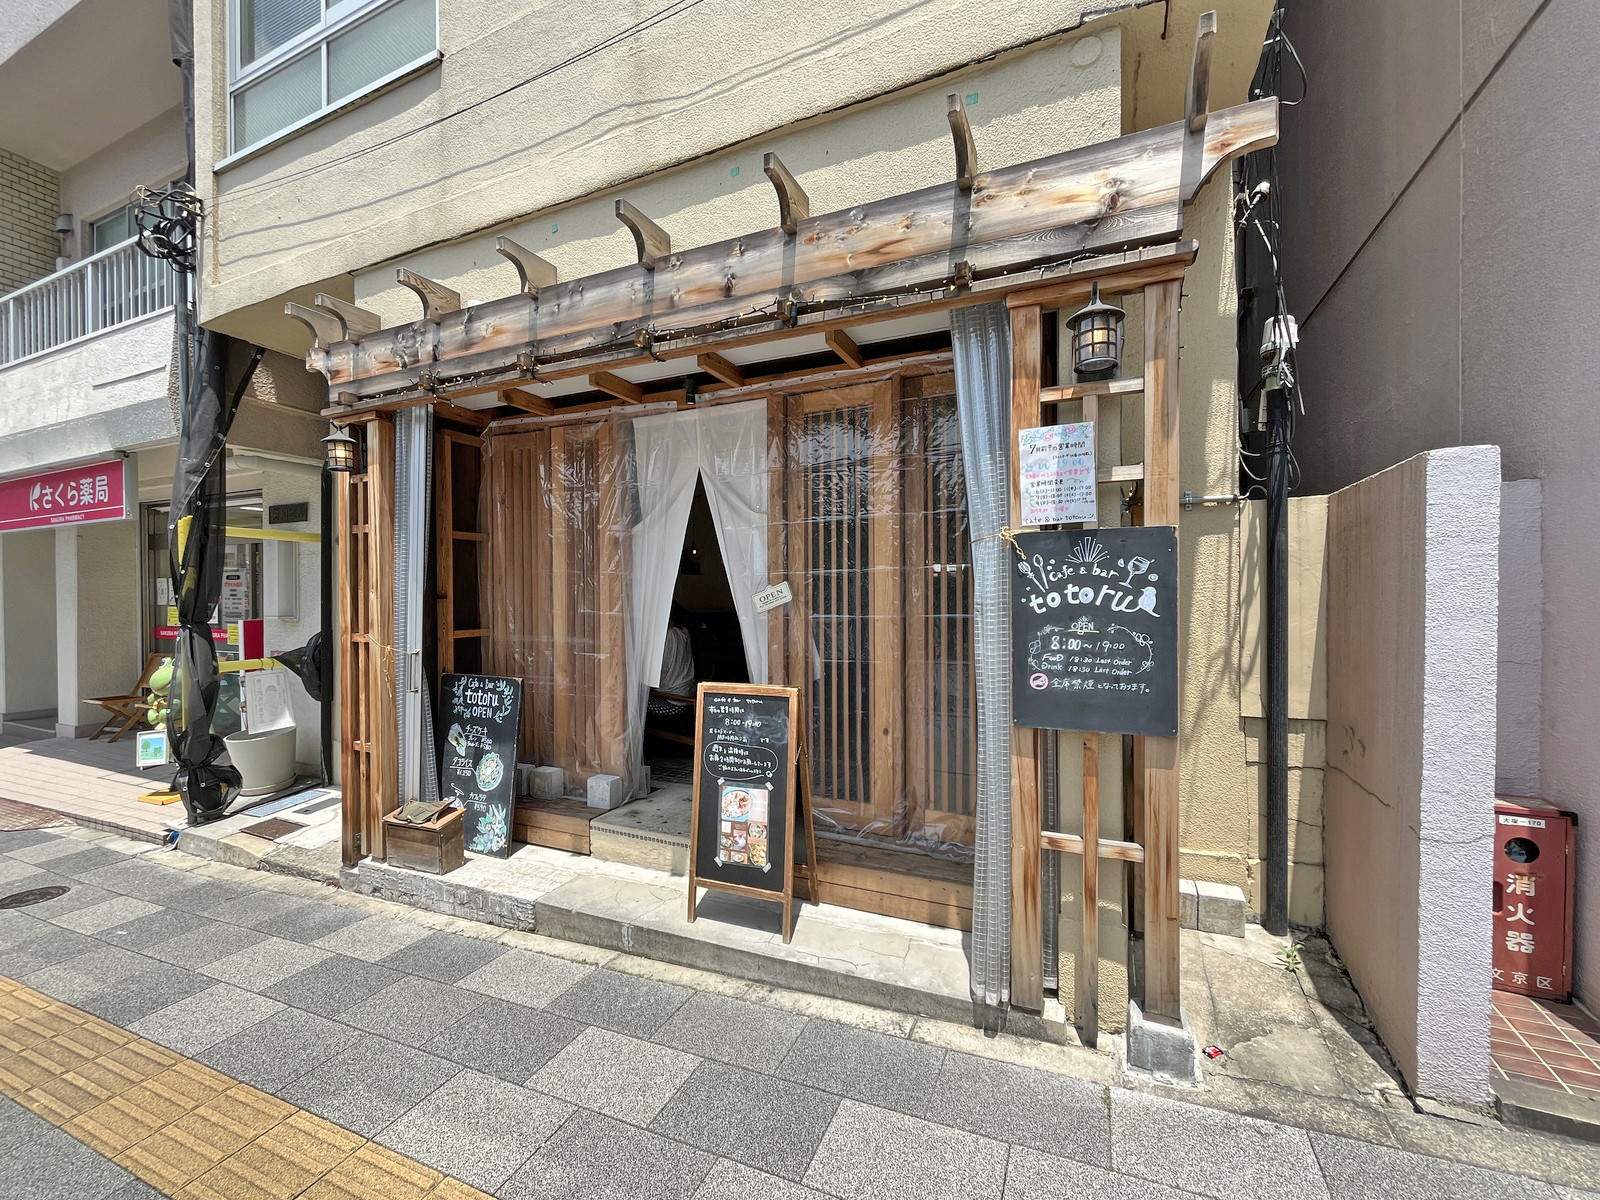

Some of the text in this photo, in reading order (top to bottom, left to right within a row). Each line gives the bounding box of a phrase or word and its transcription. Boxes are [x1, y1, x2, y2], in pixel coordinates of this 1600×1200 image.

[42, 475, 109, 509] さくら薬局
[1044, 515, 1051, 523] &
[1049, 564, 1075, 582] cafe
[1092, 562, 1120, 580] bar
[759, 588, 784, 603] OPEN
[1029, 583, 1140, 614] totoru
[1071, 621, 1095, 632] OPEN
[1041, 662, 1063, 671] Drink
[1095, 656, 1112, 665] Last
[465, 688, 499, 707] totoru
[472, 706, 493, 719] OPEN
[452, 756, 473, 767] タコライス
[1505, 873, 1537, 955] 消火器
[1492, 967, 1554, 991] 文京区
